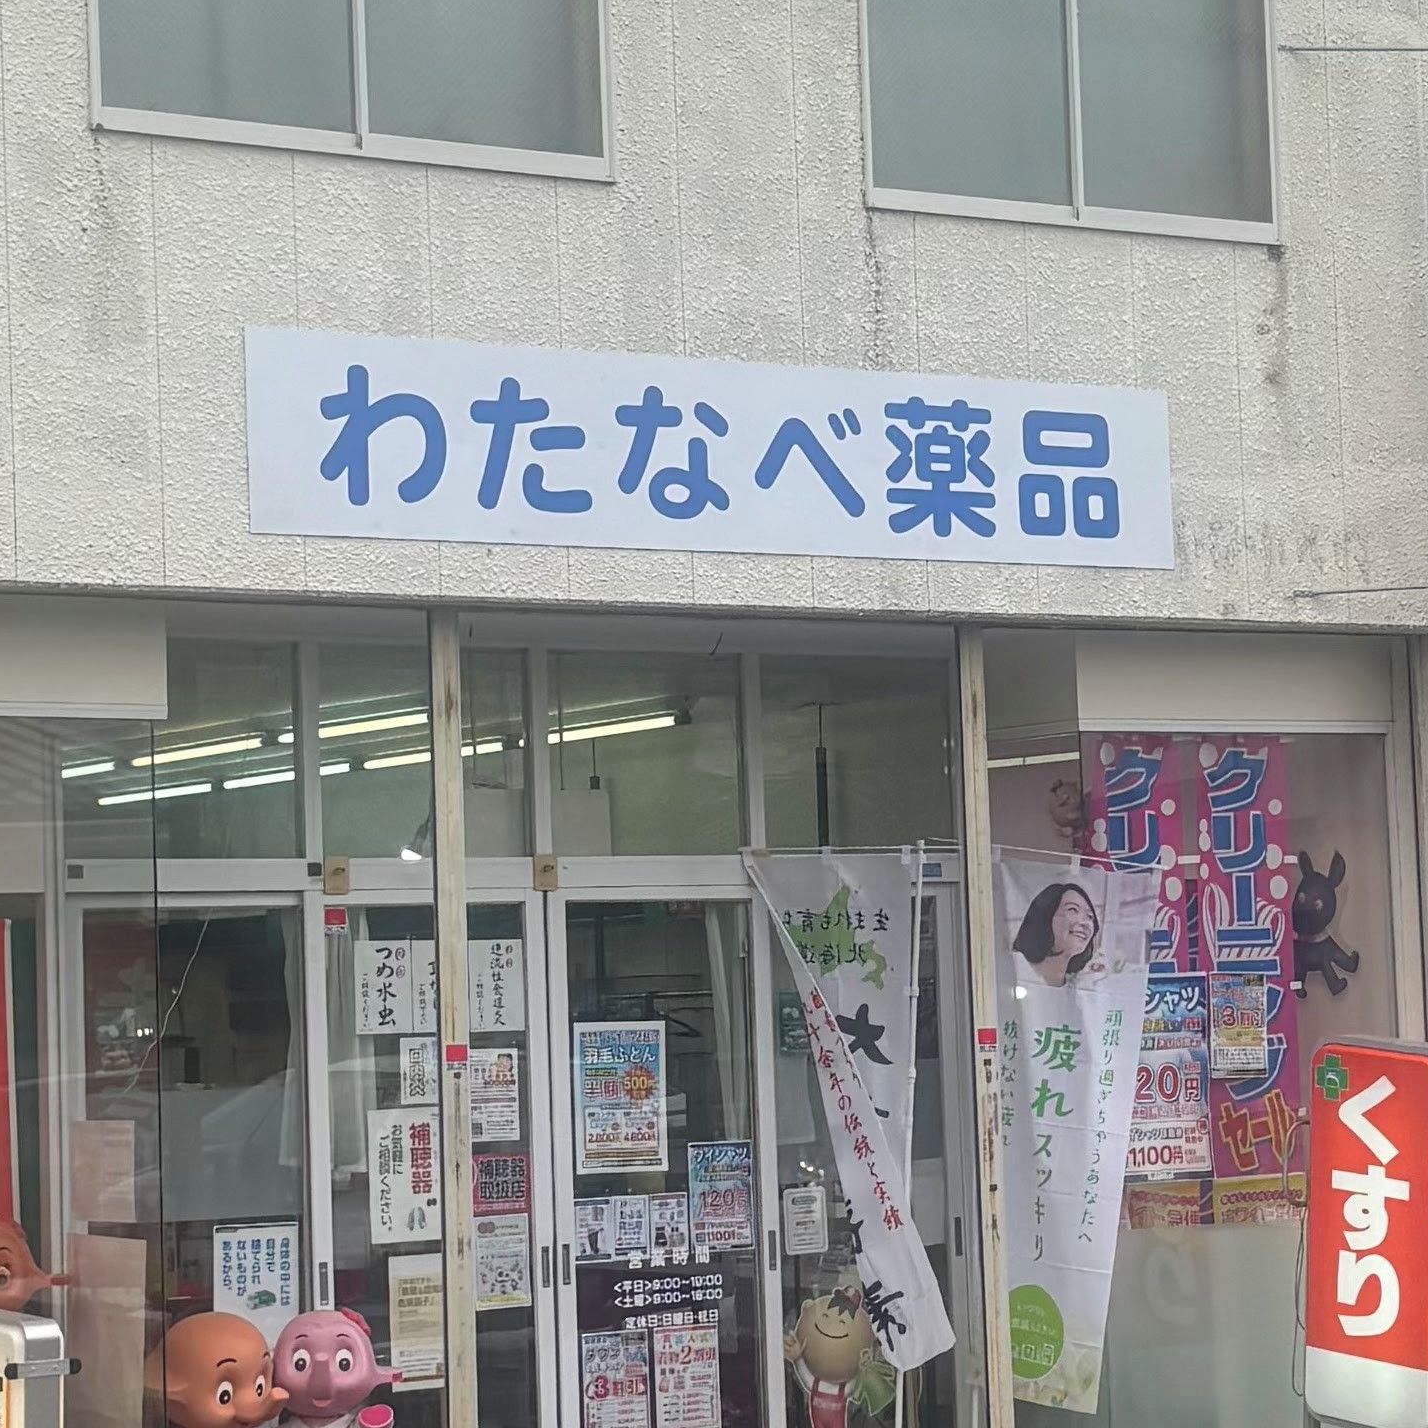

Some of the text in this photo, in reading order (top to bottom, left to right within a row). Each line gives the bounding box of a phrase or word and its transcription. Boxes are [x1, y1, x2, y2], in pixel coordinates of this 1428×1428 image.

[318, 363, 1121, 540] わたなべ薬品
[375, 946, 397, 1027] つめ水虫
[584, 1045, 656, 1064] 羽毛ふとん
[408, 1122, 433, 1195] 補聴器
[1031, 1024, 1082, 1262] 疲れスッキリ
[1077, 1009, 1124, 1243] 頑張り過ぎちゃうあなたへ
[1331, 1074, 1410, 1337] くすり
